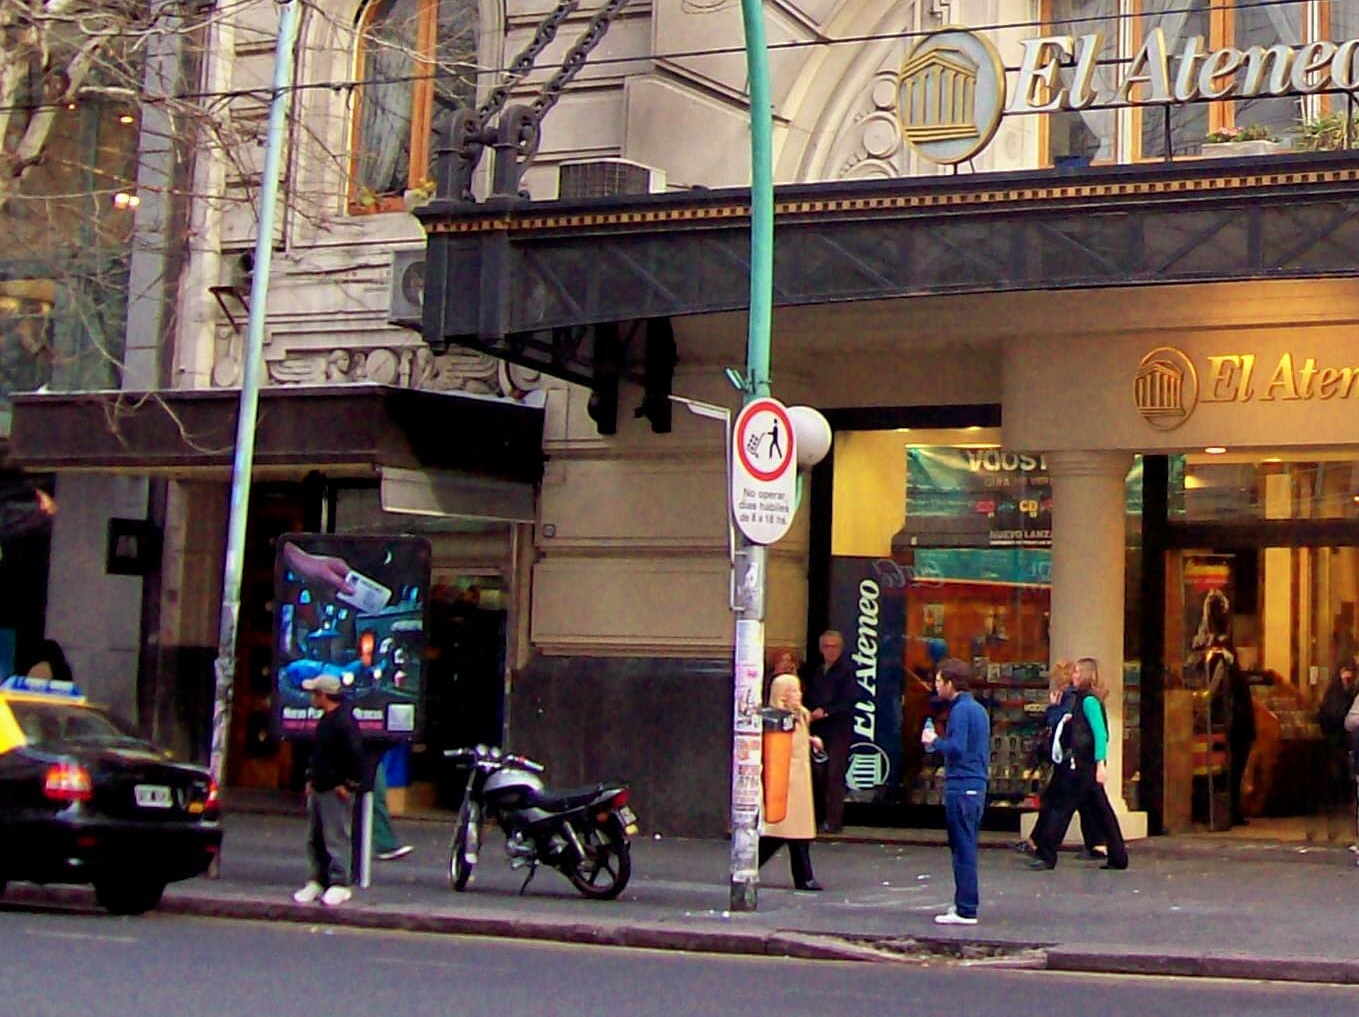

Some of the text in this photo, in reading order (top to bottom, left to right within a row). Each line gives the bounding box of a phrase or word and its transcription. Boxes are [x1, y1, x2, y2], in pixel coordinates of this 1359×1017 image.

[1004, 33, 1104, 113] El
[1200, 353, 1256, 403] El
[743, 488, 785, 500] No operar
[1019, 500, 1039, 513] CD
[851, 579, 881, 742] El Ateneo
